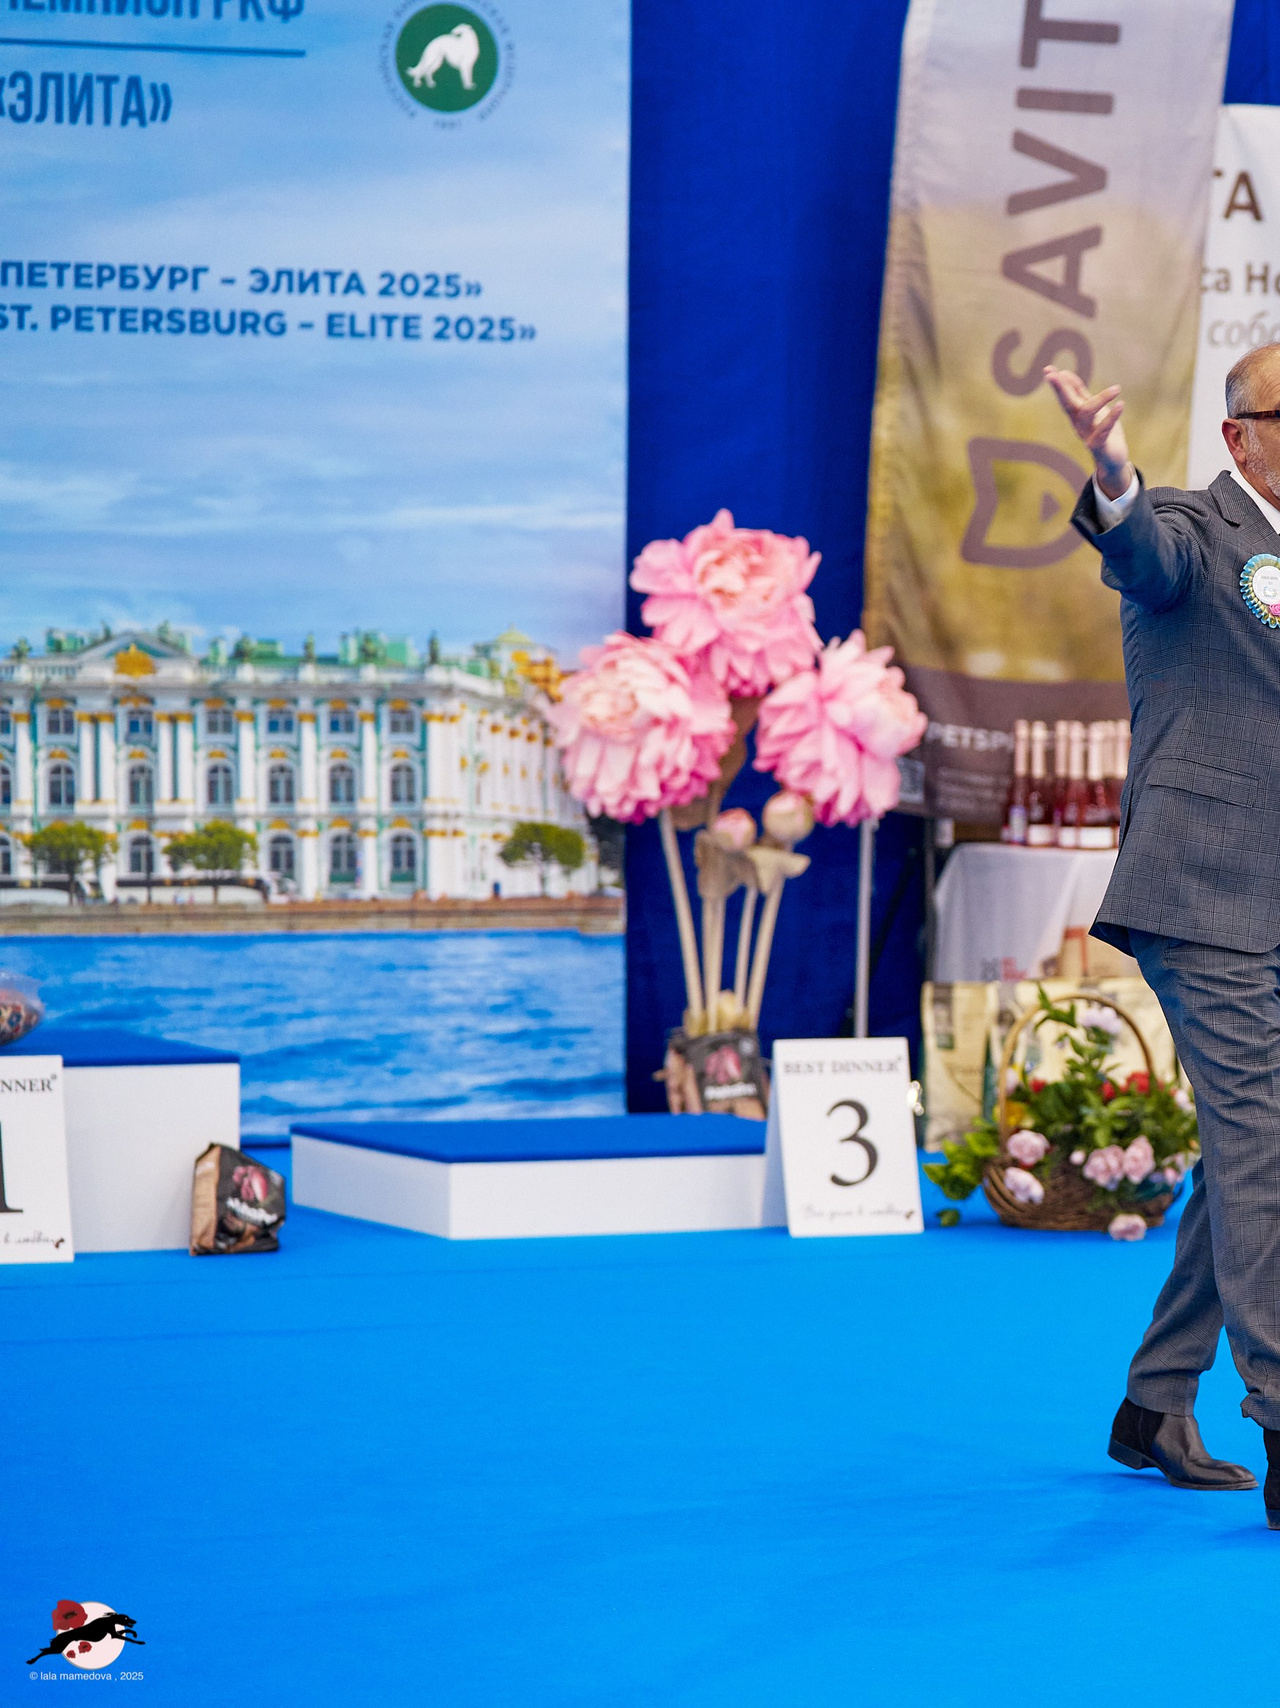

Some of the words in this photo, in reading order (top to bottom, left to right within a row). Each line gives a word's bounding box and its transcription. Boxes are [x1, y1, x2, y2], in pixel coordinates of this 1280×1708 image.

[249, 268, 367, 297] ЭЛИТА
[378, 271, 482, 299] 2025»
[50, 305, 287, 337] PETERSBURG
[326, 312, 422, 340] ELITE
[434, 315, 537, 343] 2025»
[826, 1100, 879, 1187] 3
